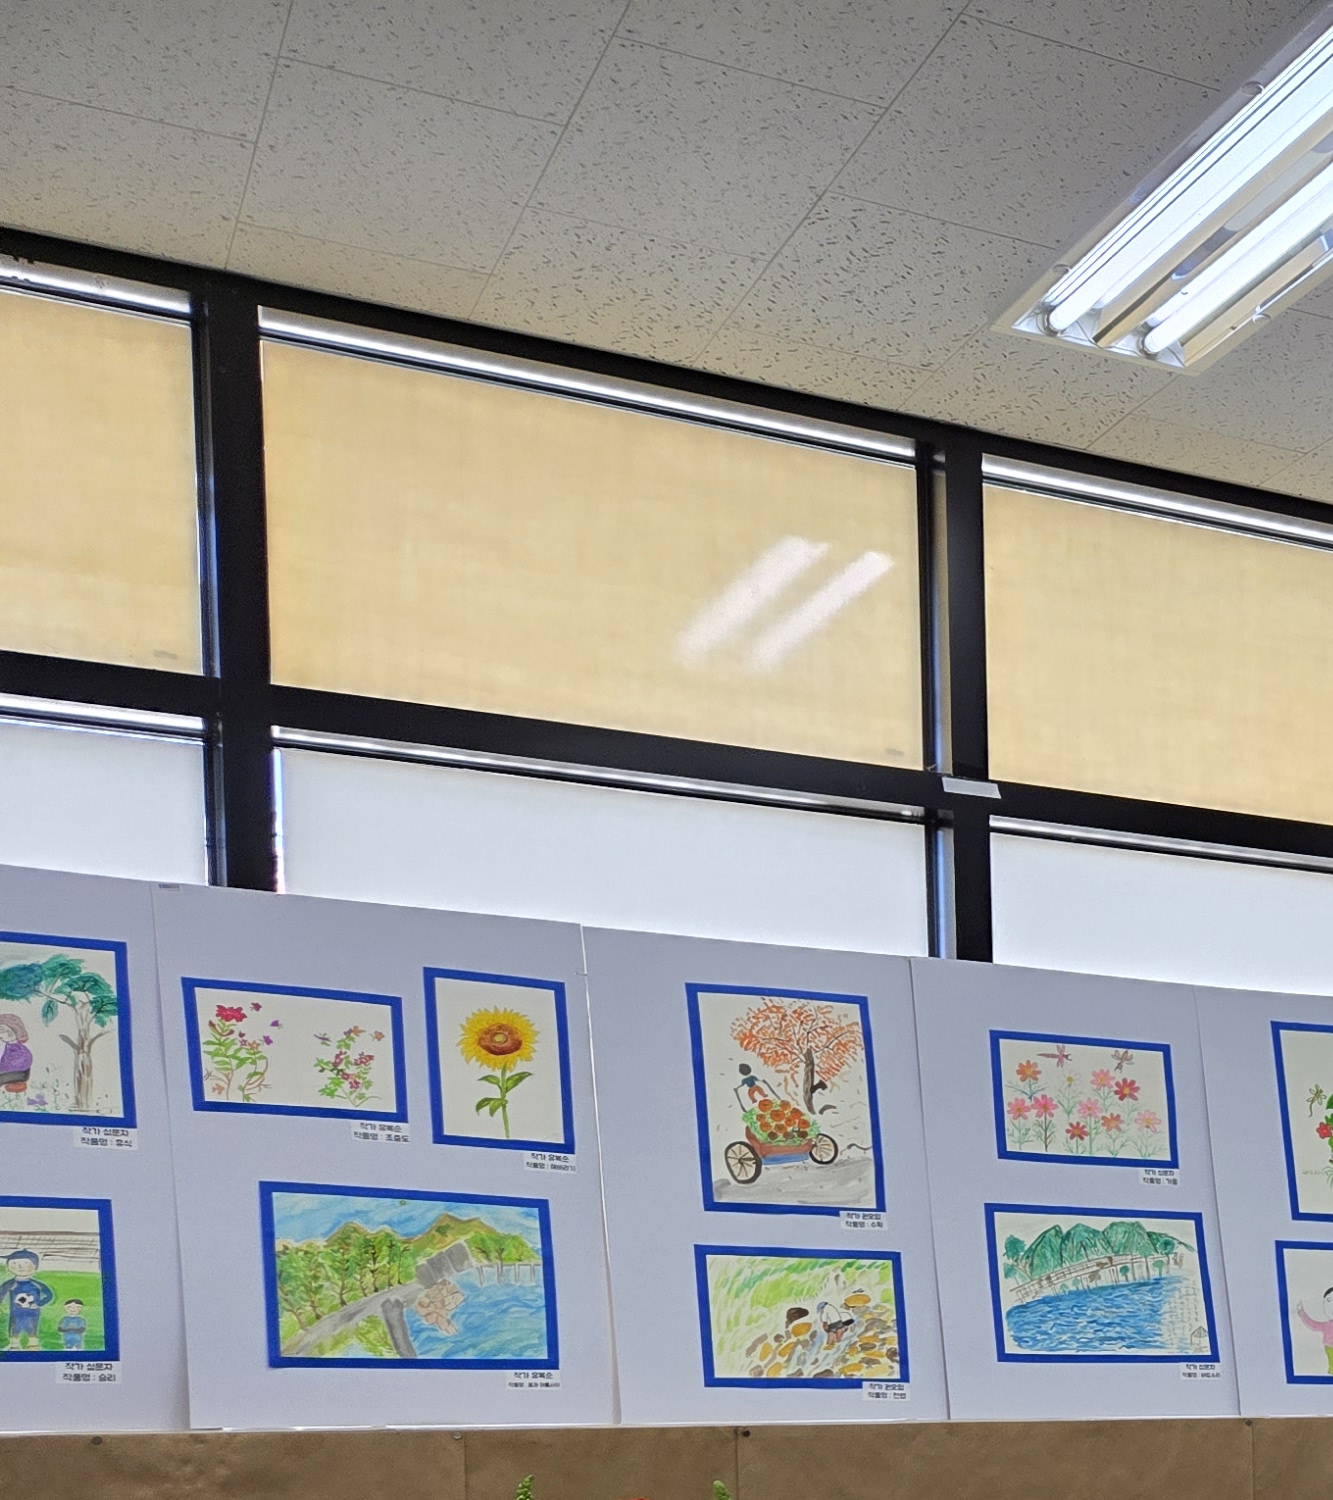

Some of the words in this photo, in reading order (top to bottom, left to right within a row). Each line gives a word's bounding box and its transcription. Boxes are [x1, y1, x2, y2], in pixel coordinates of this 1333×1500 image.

[82, 1127, 100, 1135] 작가
[360, 1123, 376, 1131] 작가
[353, 1131, 379, 1141] 작품명
[81, 1137, 108, 1146] 작품명
[531, 1153, 546, 1161] 작가
[65, 1363, 84, 1371] 작가
[63, 1373, 91, 1382] 작품명
